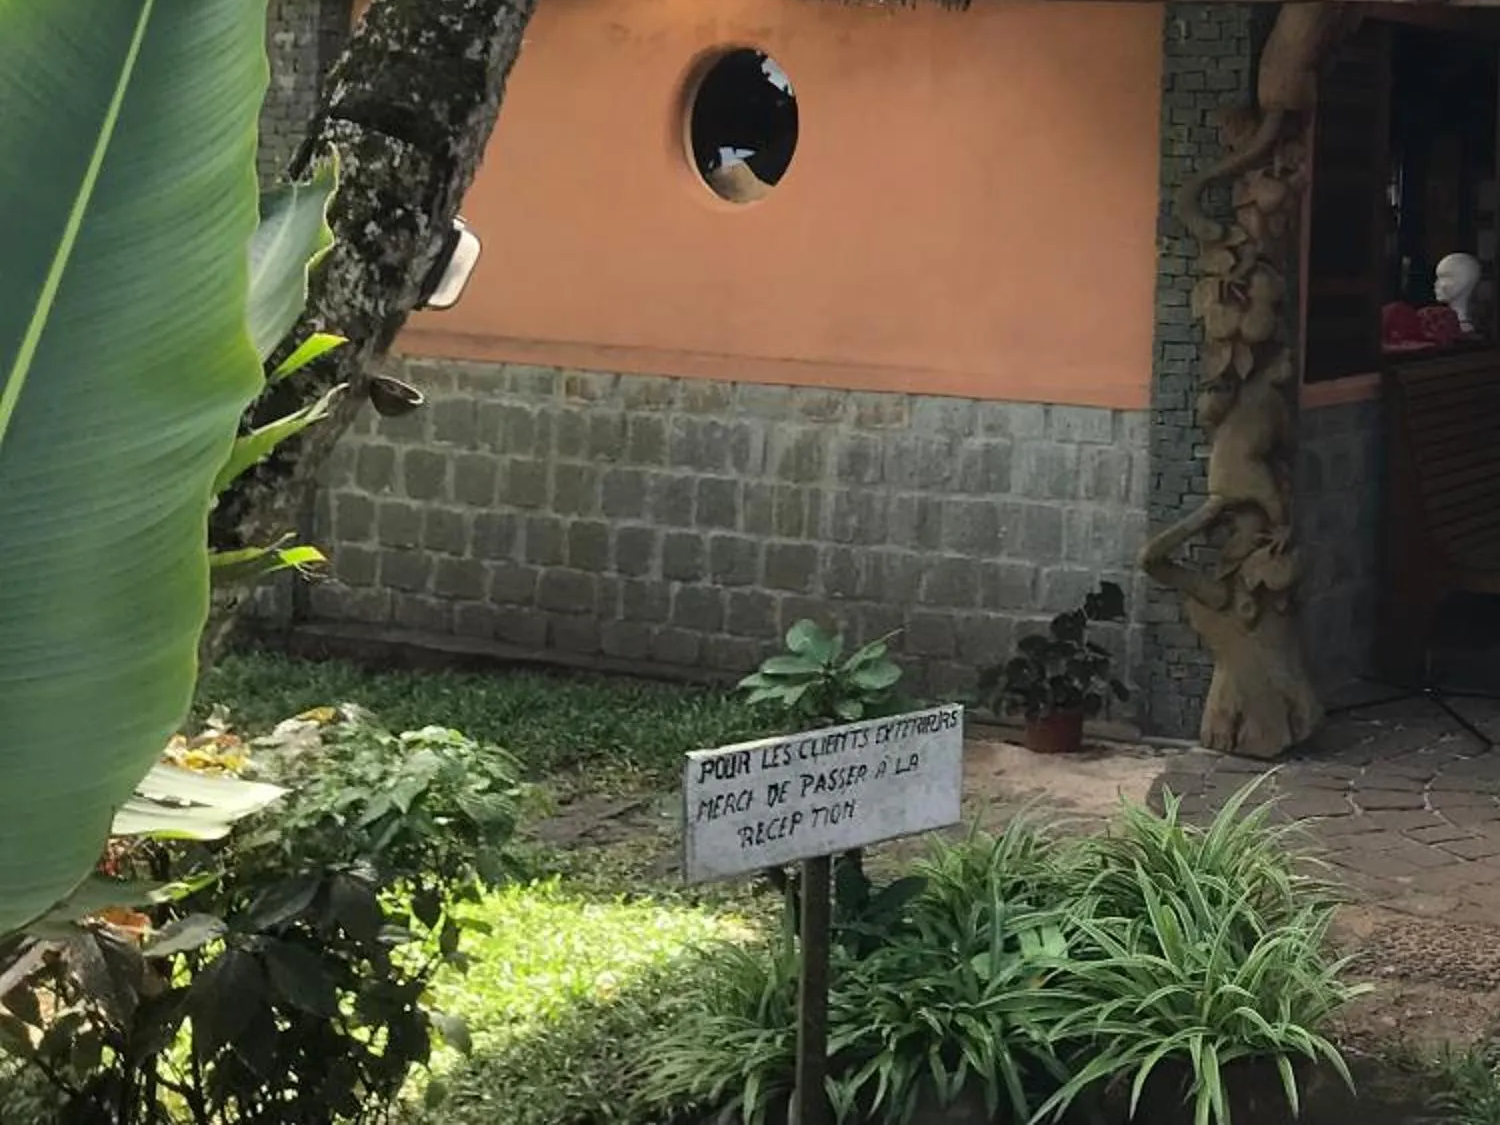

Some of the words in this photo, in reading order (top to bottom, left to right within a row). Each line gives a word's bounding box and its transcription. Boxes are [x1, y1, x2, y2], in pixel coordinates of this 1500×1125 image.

[698, 750, 751, 784] POUR
[761, 743, 792, 770] LES
[798, 728, 869, 760] CLIENTS
[696, 788, 753, 823] MERCI
[767, 780, 791, 808] DE
[800, 763, 868, 798] PASSER
[895, 753, 919, 774] LA
